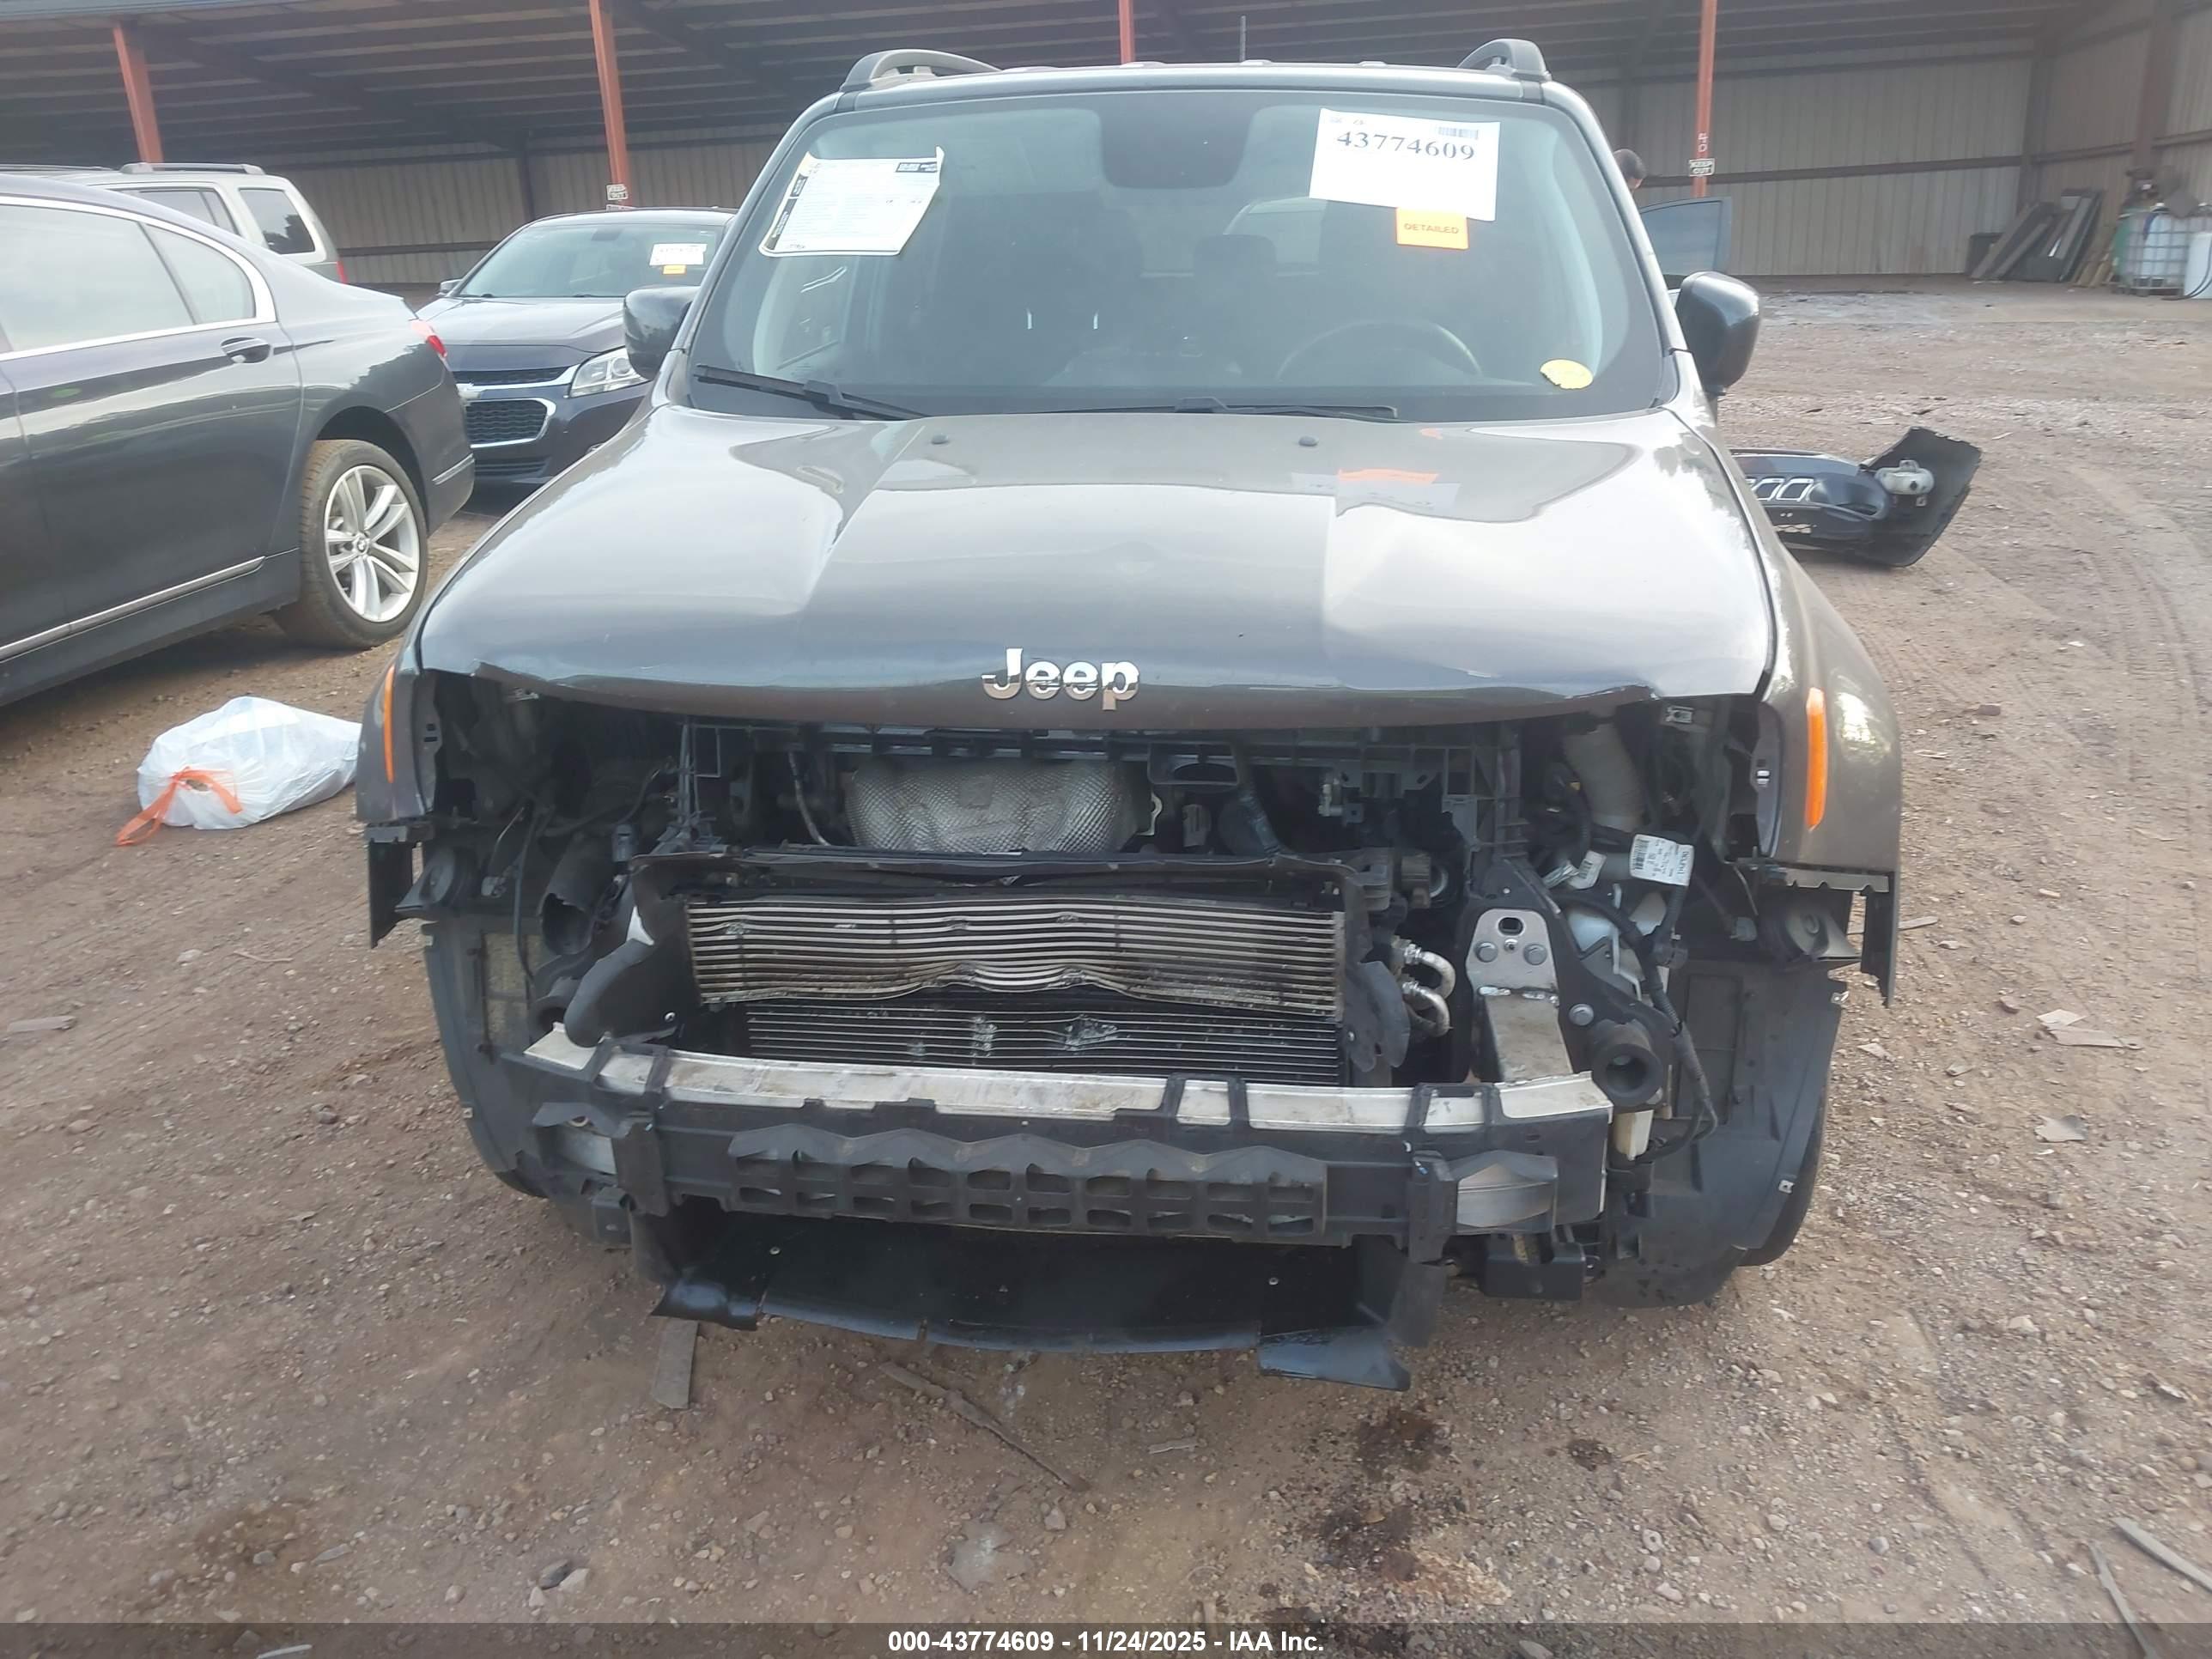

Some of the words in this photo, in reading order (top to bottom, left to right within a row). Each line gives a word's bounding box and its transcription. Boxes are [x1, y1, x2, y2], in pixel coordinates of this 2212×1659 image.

[1336, 131, 1475, 161] 43774609
[1403, 222, 1460, 235] DETAILED
[981, 647, 1140, 711] Jeep
